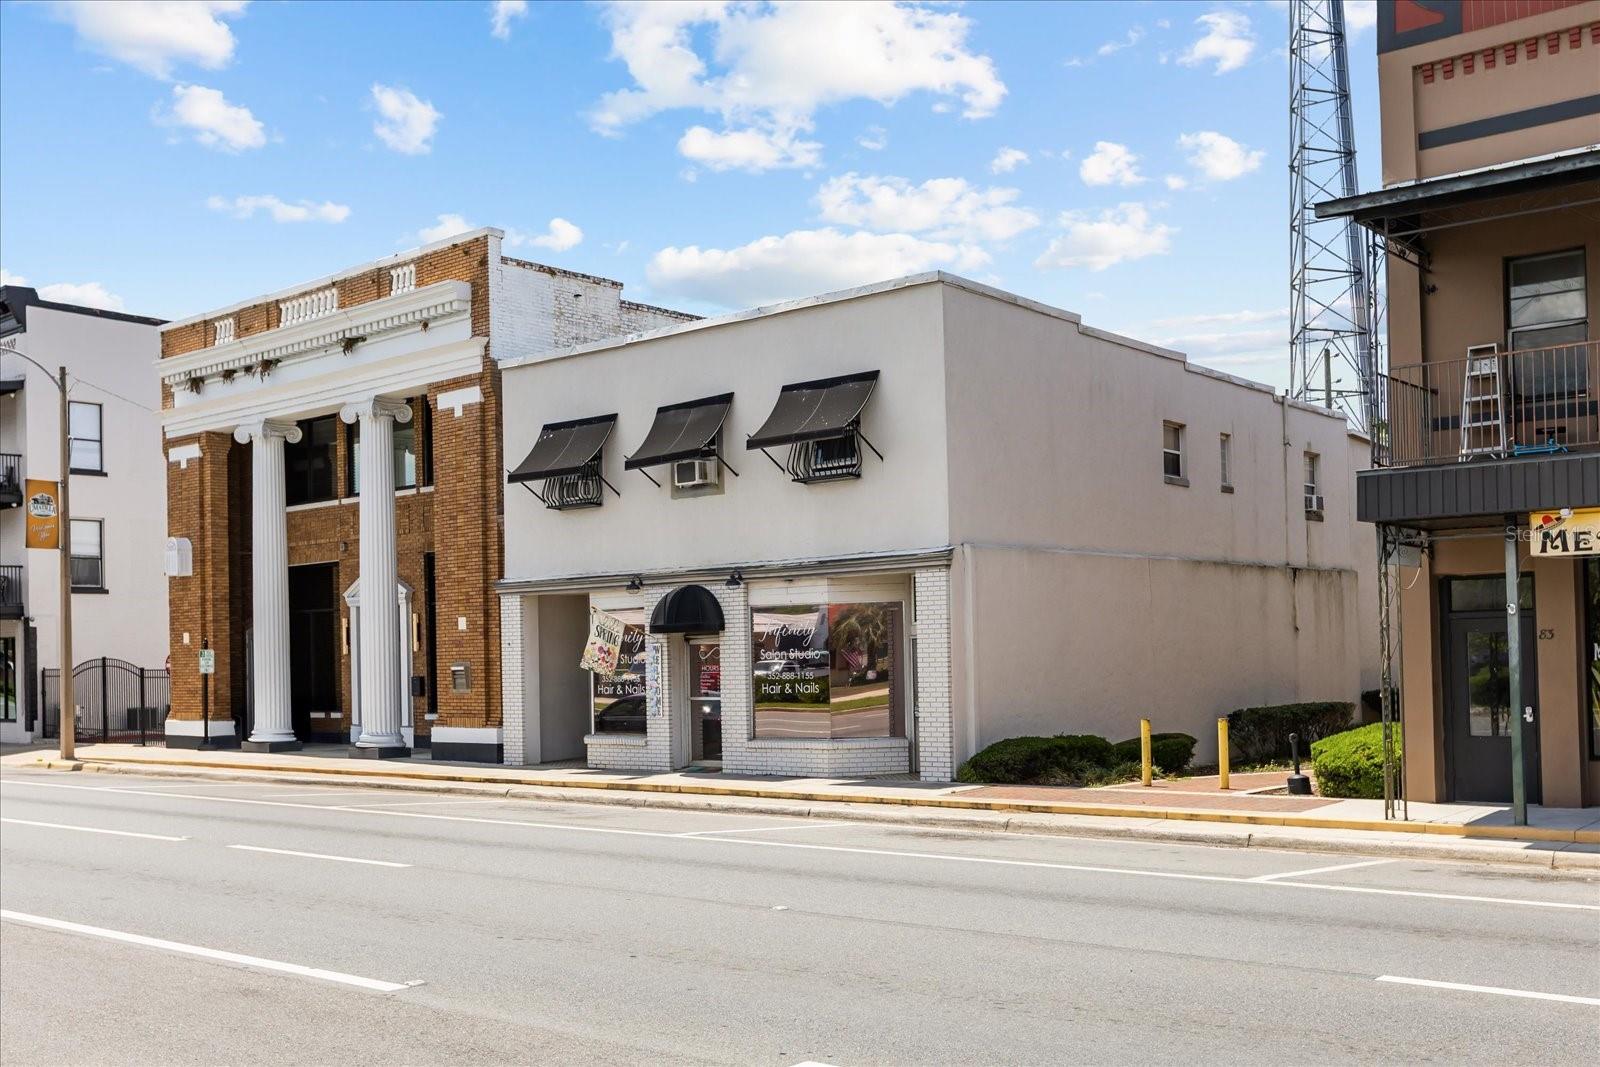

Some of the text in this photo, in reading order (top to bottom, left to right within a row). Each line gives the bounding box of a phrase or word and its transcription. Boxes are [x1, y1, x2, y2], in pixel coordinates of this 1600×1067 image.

[759, 619, 817, 647] Infinity
[760, 648, 821, 660] Salon Studio
[597, 683, 647, 695] Hair & Nails
[761, 682, 820, 694] Hair & Nails
